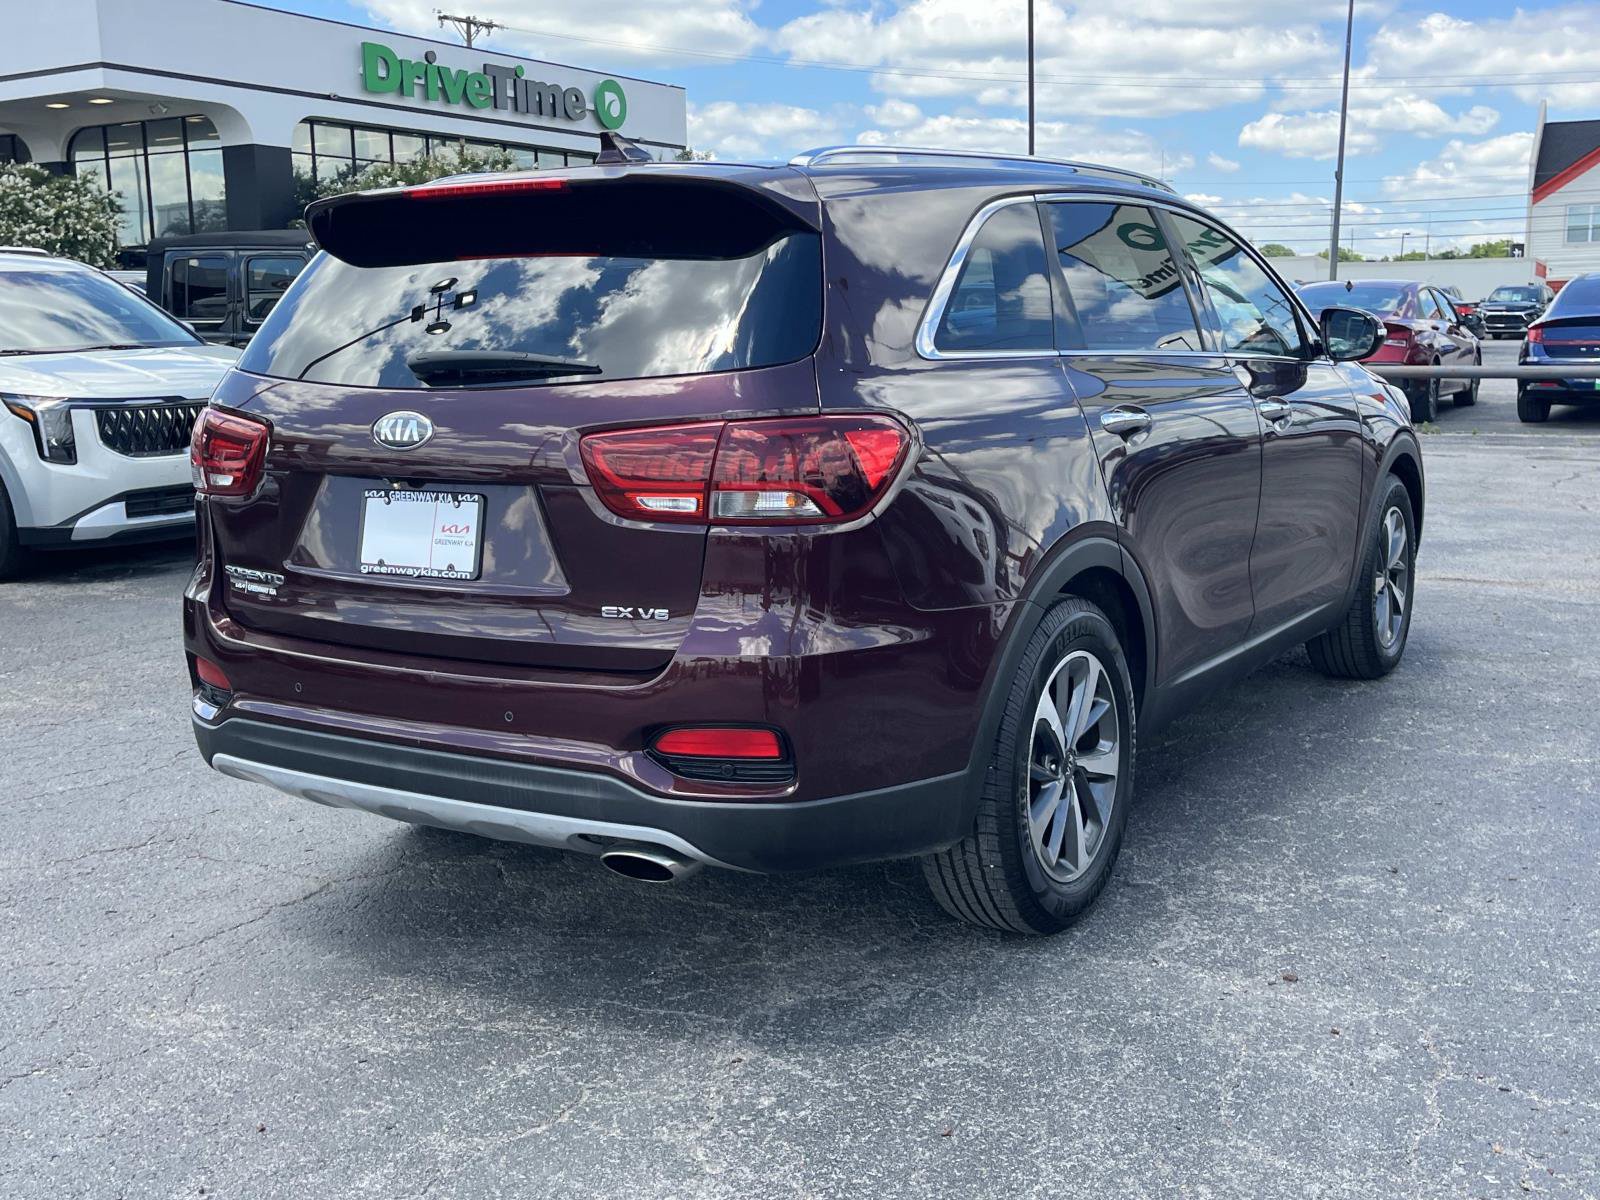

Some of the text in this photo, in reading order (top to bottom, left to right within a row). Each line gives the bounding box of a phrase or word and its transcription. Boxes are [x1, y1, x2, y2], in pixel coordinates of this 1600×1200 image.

[361, 42, 587, 122] DriveTime
[380, 418, 420, 442] KIA
[389, 490, 453, 503] GREENWAY KIA
[434, 538, 463, 546] GREENWAY
[224, 565, 285, 585] SORENTO
[360, 565, 471, 579] greenwaykia.com
[601, 605, 669, 621] EX V6
